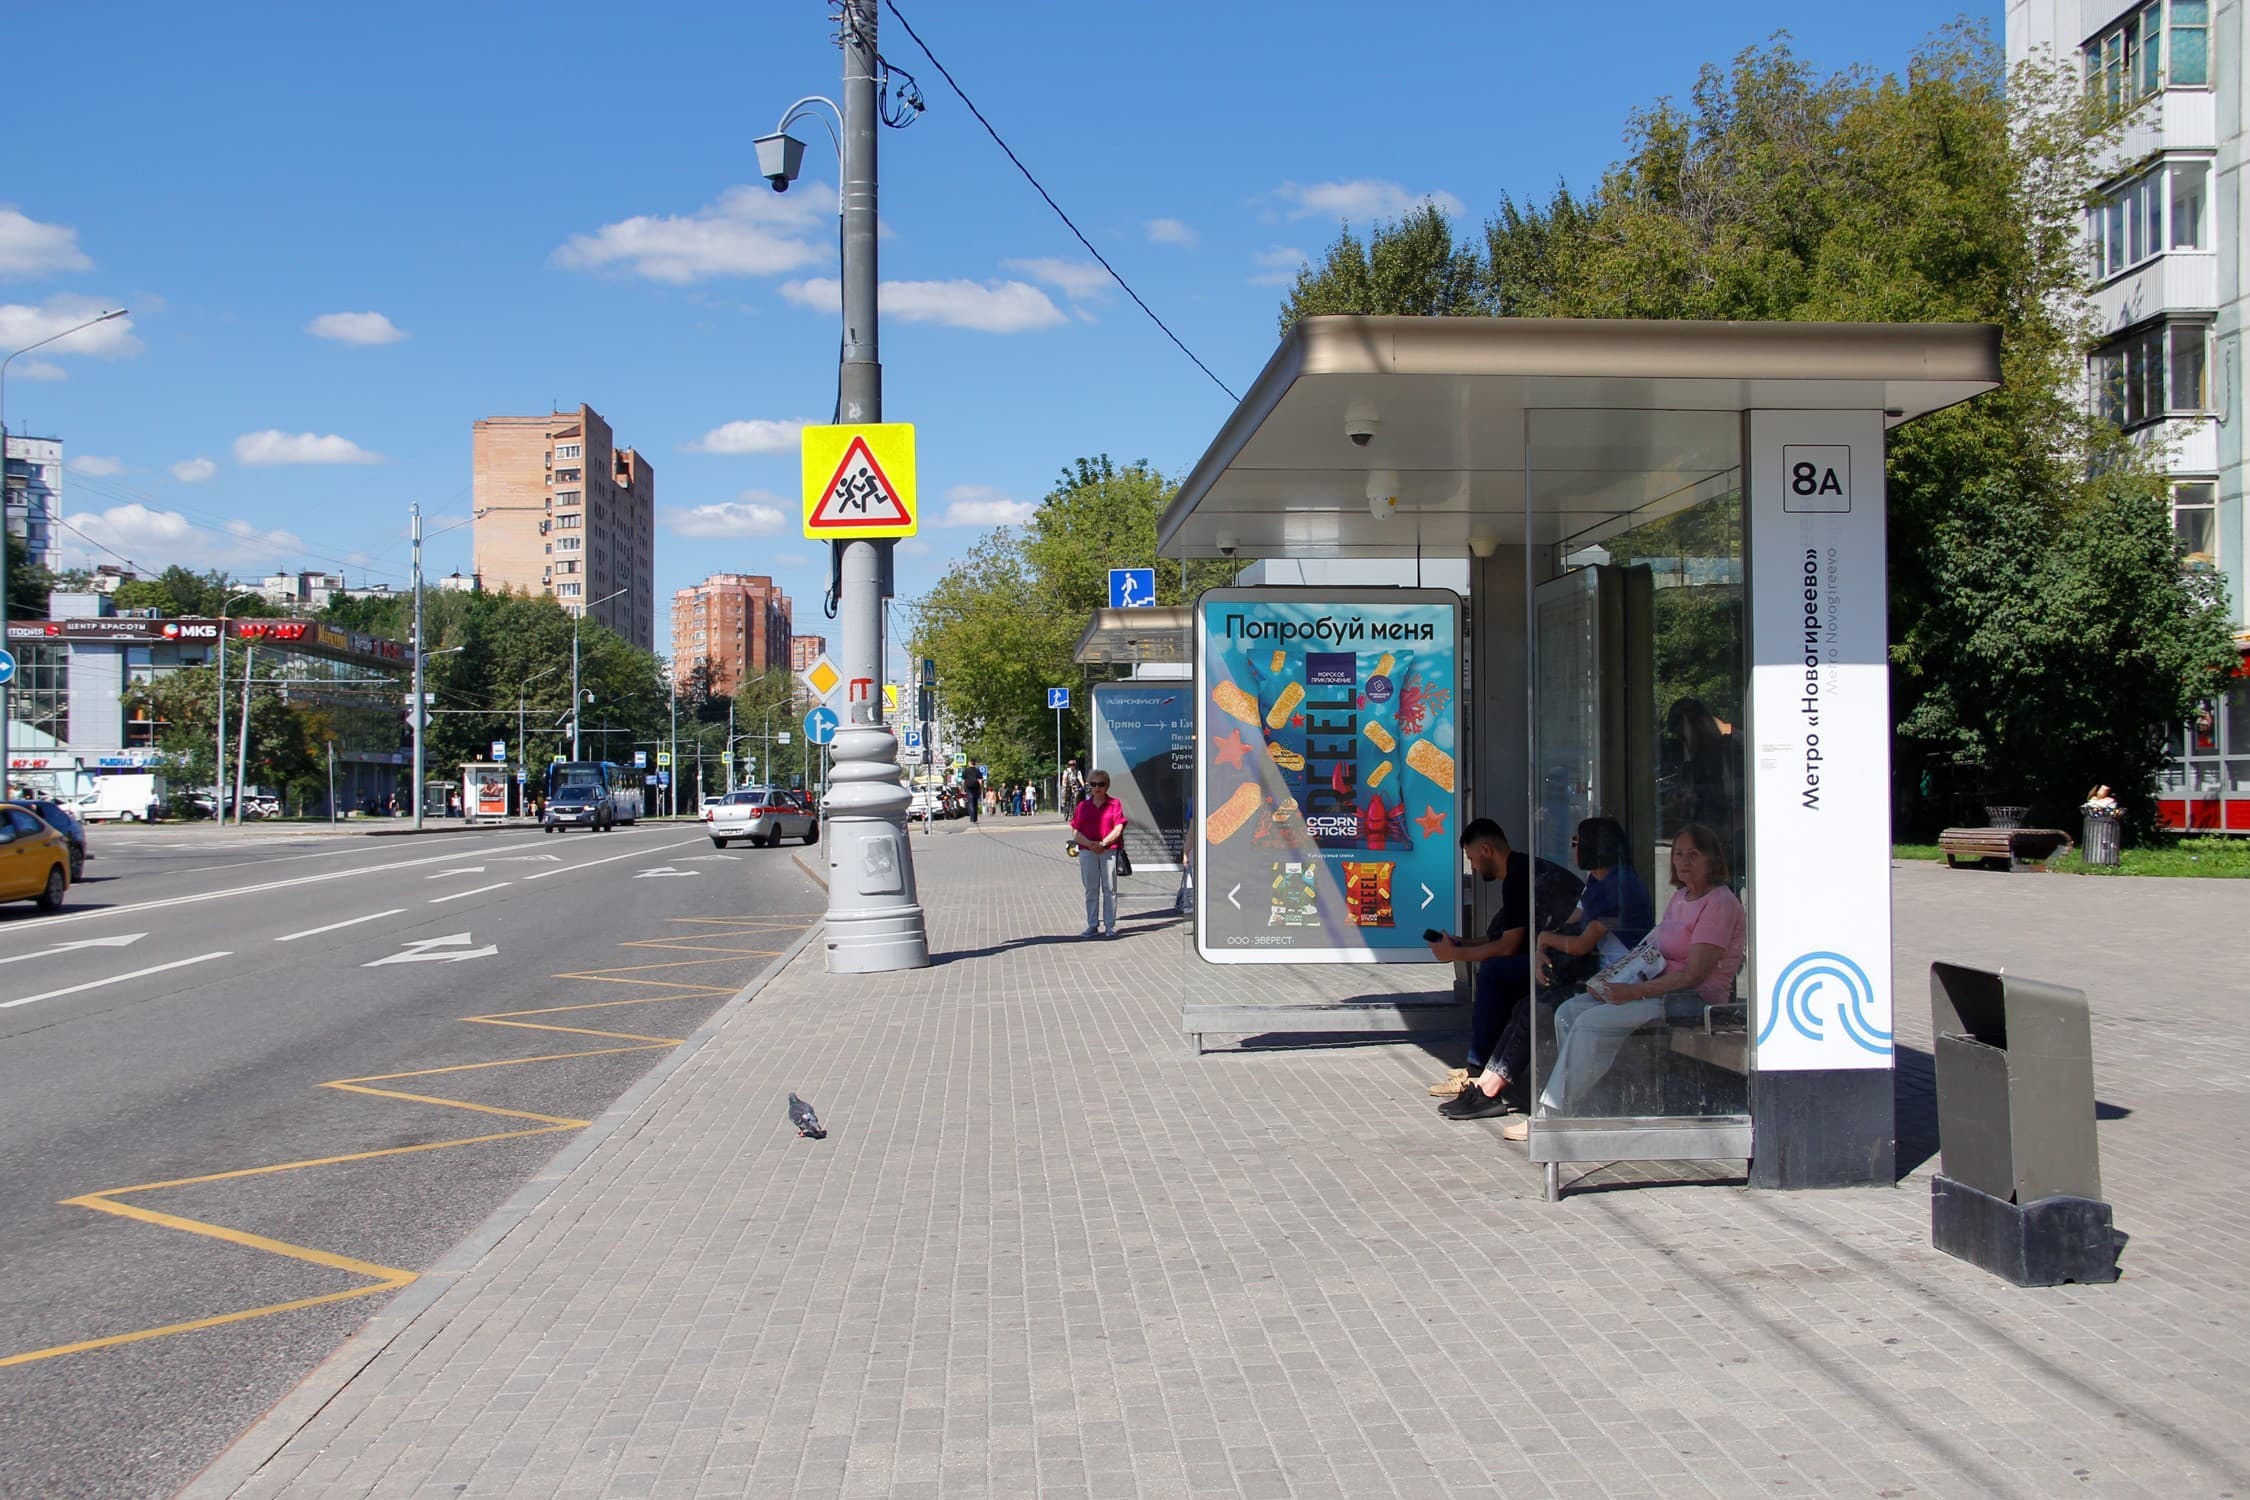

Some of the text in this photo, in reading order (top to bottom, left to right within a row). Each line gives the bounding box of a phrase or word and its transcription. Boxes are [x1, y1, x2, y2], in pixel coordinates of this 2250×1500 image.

[1791, 461, 1843, 496] 8А
[1825, 547, 1841, 644] Novogireevo
[66, 622, 147, 631] ЦЕНТР КРАСОТЫ
[181, 625, 217, 637] МКБ
[1226, 613, 1434, 645] Попробуй меня
[1801, 548, 1823, 811] Метро «Новогиреево»
[1106, 719, 1142, 732] Прямо
[1306, 816, 1358, 826] CORN
[1306, 827, 1358, 837] STICKS
[1227, 936, 1250, 945] ООО
